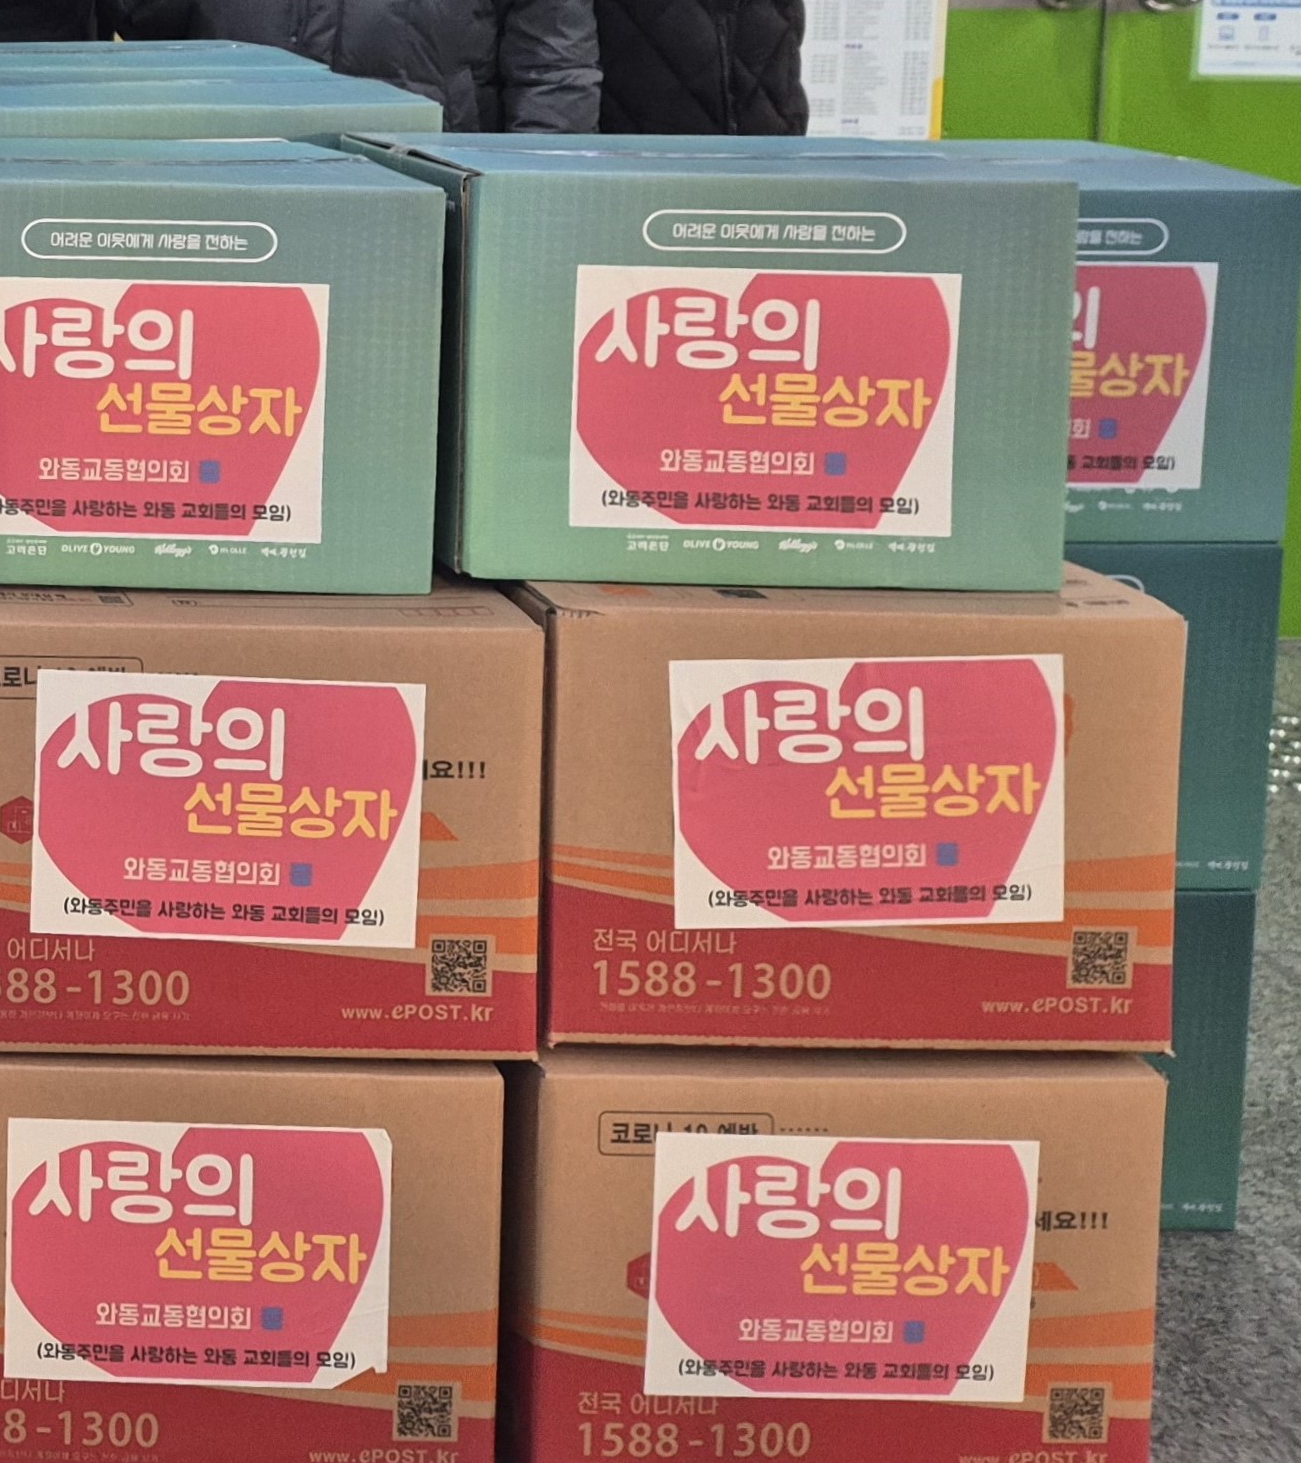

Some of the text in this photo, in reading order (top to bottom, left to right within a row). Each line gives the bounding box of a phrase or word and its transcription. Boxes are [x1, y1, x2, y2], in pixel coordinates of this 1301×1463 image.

[48, 232, 250, 251] 어려운 이웃에게 사랑을 전하는
[596, 295, 817, 371] 사랑의
[1070, 351, 1189, 397] 물상자
[97, 382, 302, 436] 선물상자
[720, 373, 930, 427] 선물상자
[40, 458, 189, 482] 와동교동협의회
[661, 450, 814, 474] 와동교동협의회
[57, 700, 284, 781] 사랑의
[695, 686, 923, 764] 사랑의
[185, 782, 397, 838] 선물상자
[826, 763, 1040, 818] 선물상자
[124, 858, 279, 885] 와동교동협의회
[769, 843, 925, 869] 와동교동협의회
[593, 960, 831, 999] 1588-1300
[341, 1002, 494, 1022] www.ePOST.kr
[980, 996, 1133, 1014] www.ePOST.kr
[29, 1148, 252, 1226] 사랑의
[675, 1163, 901, 1240] 사랑의
[156, 1227, 366, 1282] 선물상자
[800, 1242, 1010, 1296] 선물상자
[97, 1303, 250, 1329] 와동교동협의회
[739, 1319, 892, 1342] 와동교동협의회
